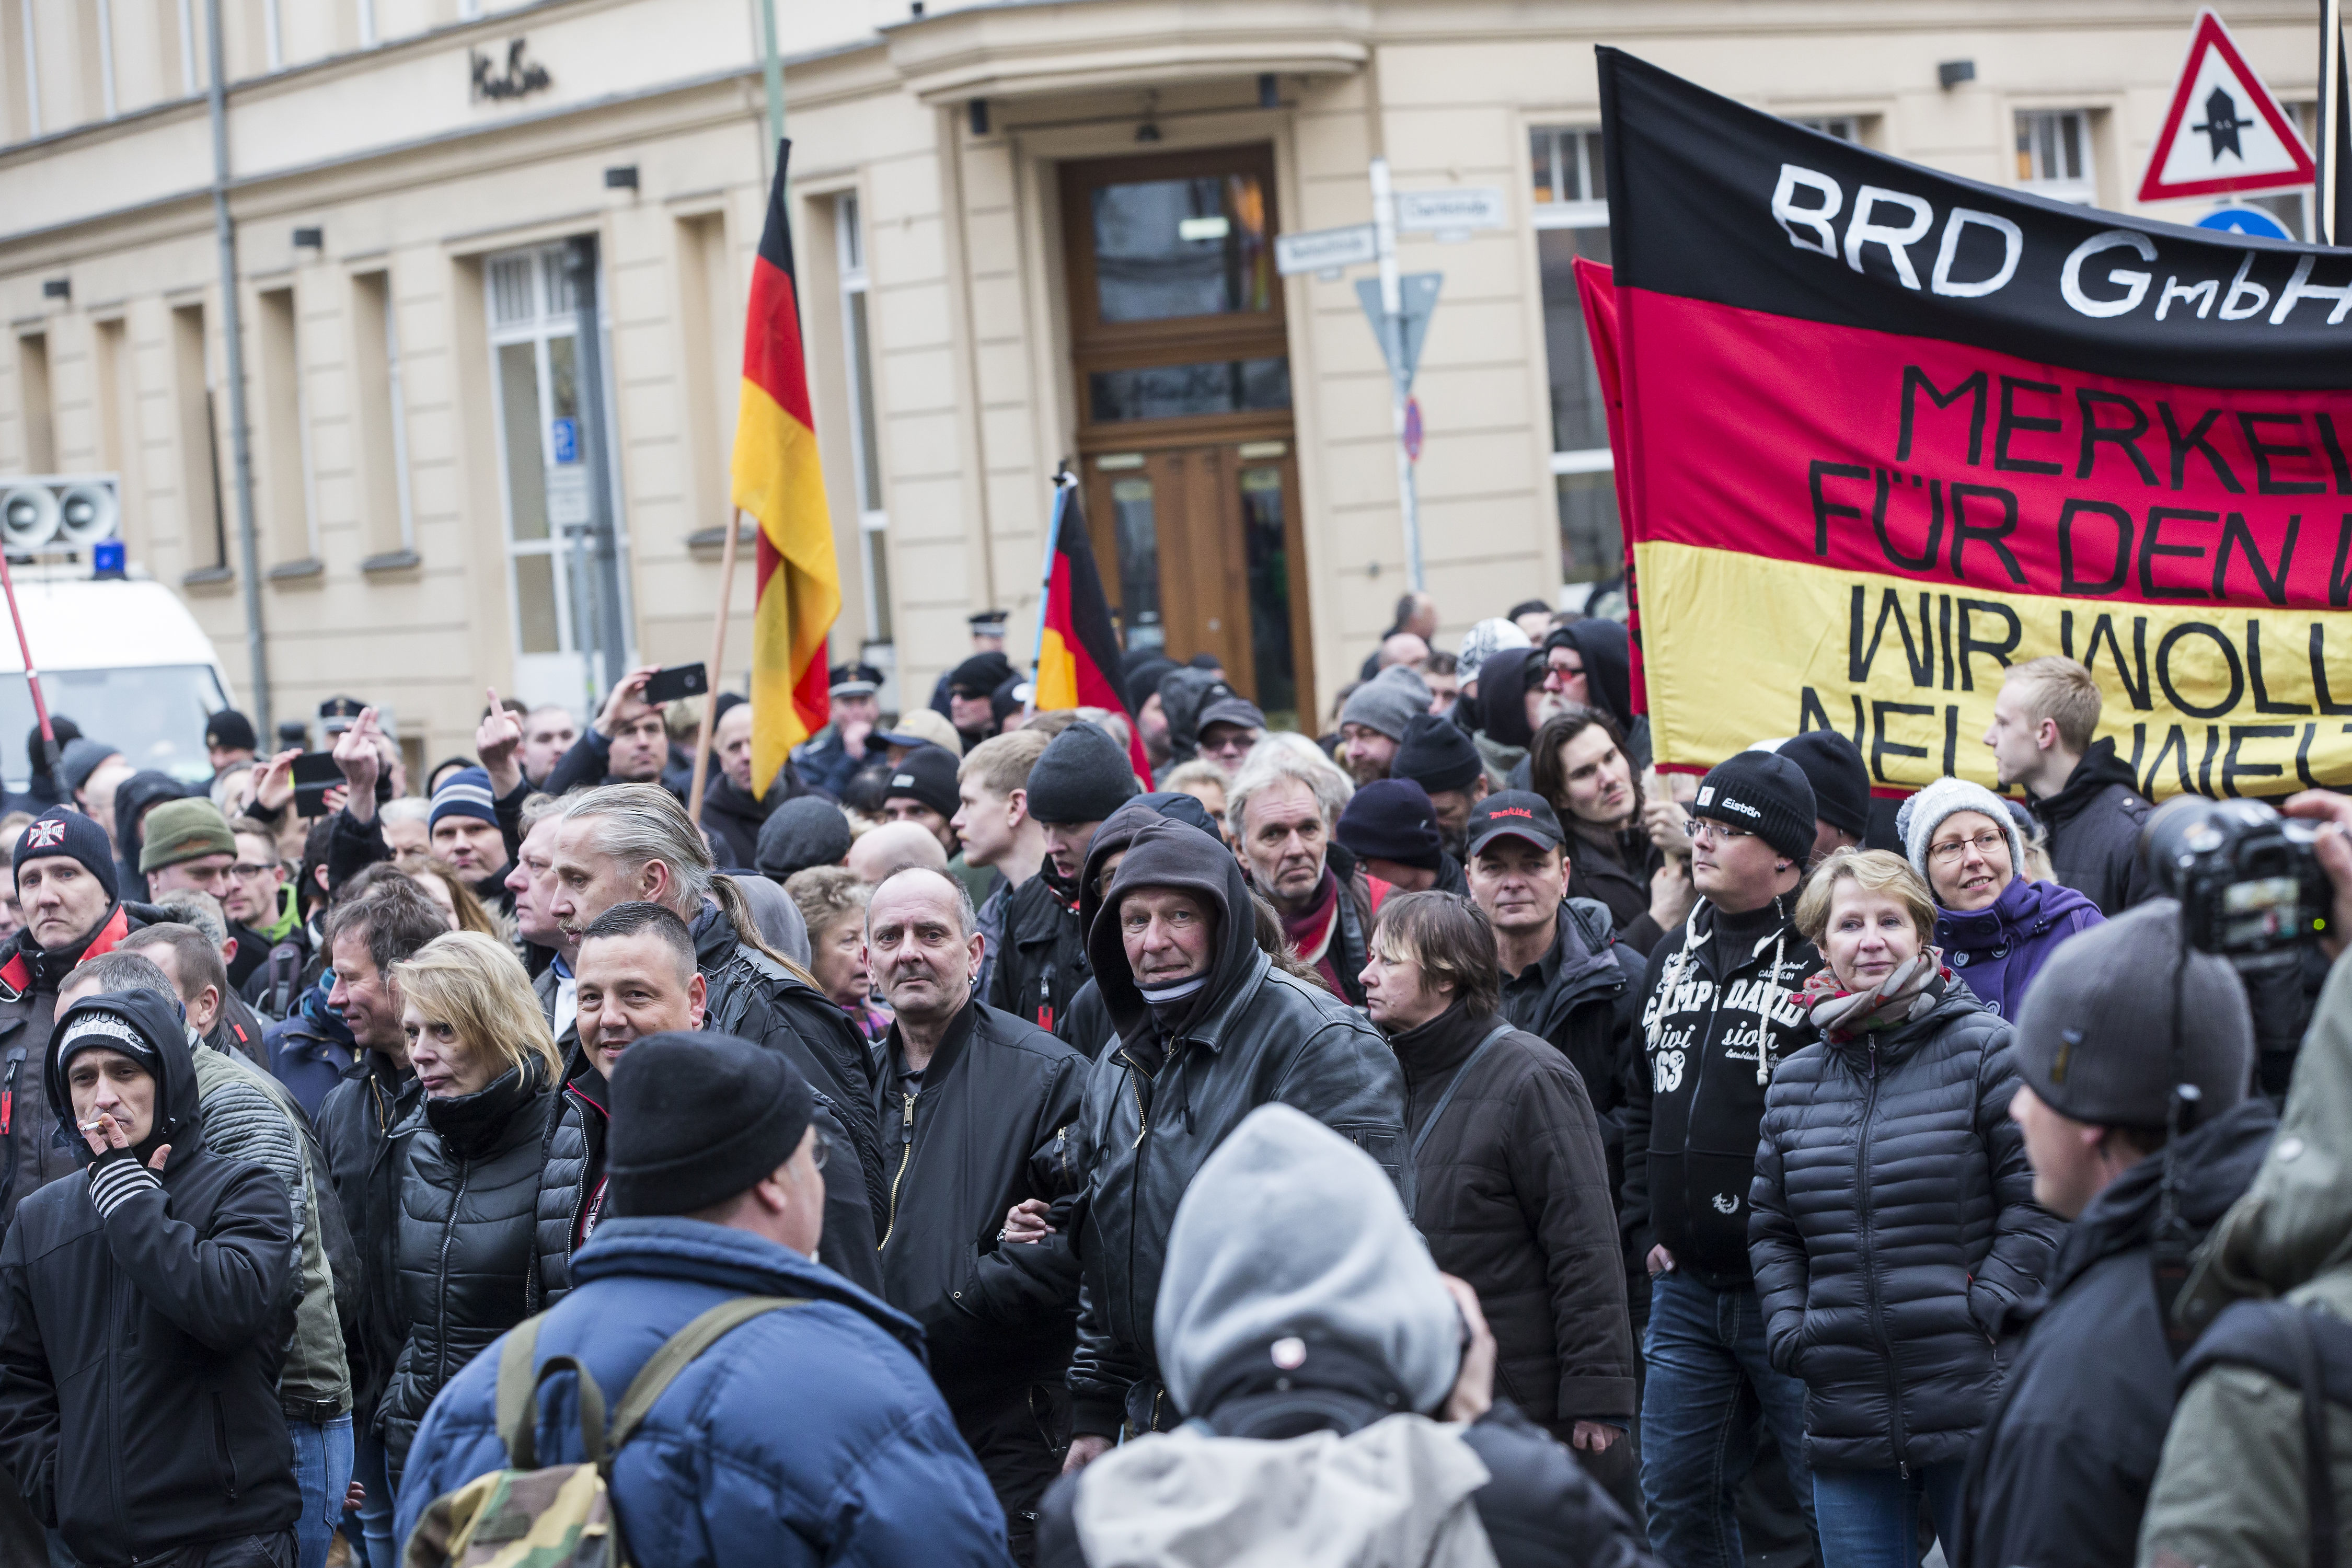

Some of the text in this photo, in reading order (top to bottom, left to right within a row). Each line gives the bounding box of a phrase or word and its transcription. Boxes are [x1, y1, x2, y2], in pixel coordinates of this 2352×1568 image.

[1771, 164, 2352, 325] BRD GmbH
[1809, 460, 2027, 584] FÜR
[2060, 498, 2302, 605] DEN
[1849, 584, 2022, 691] WIR
[1722, 797, 1761, 818] Eisbär
[2130, 723, 2352, 806] WEL
[1489, 806, 1532, 820] makita
